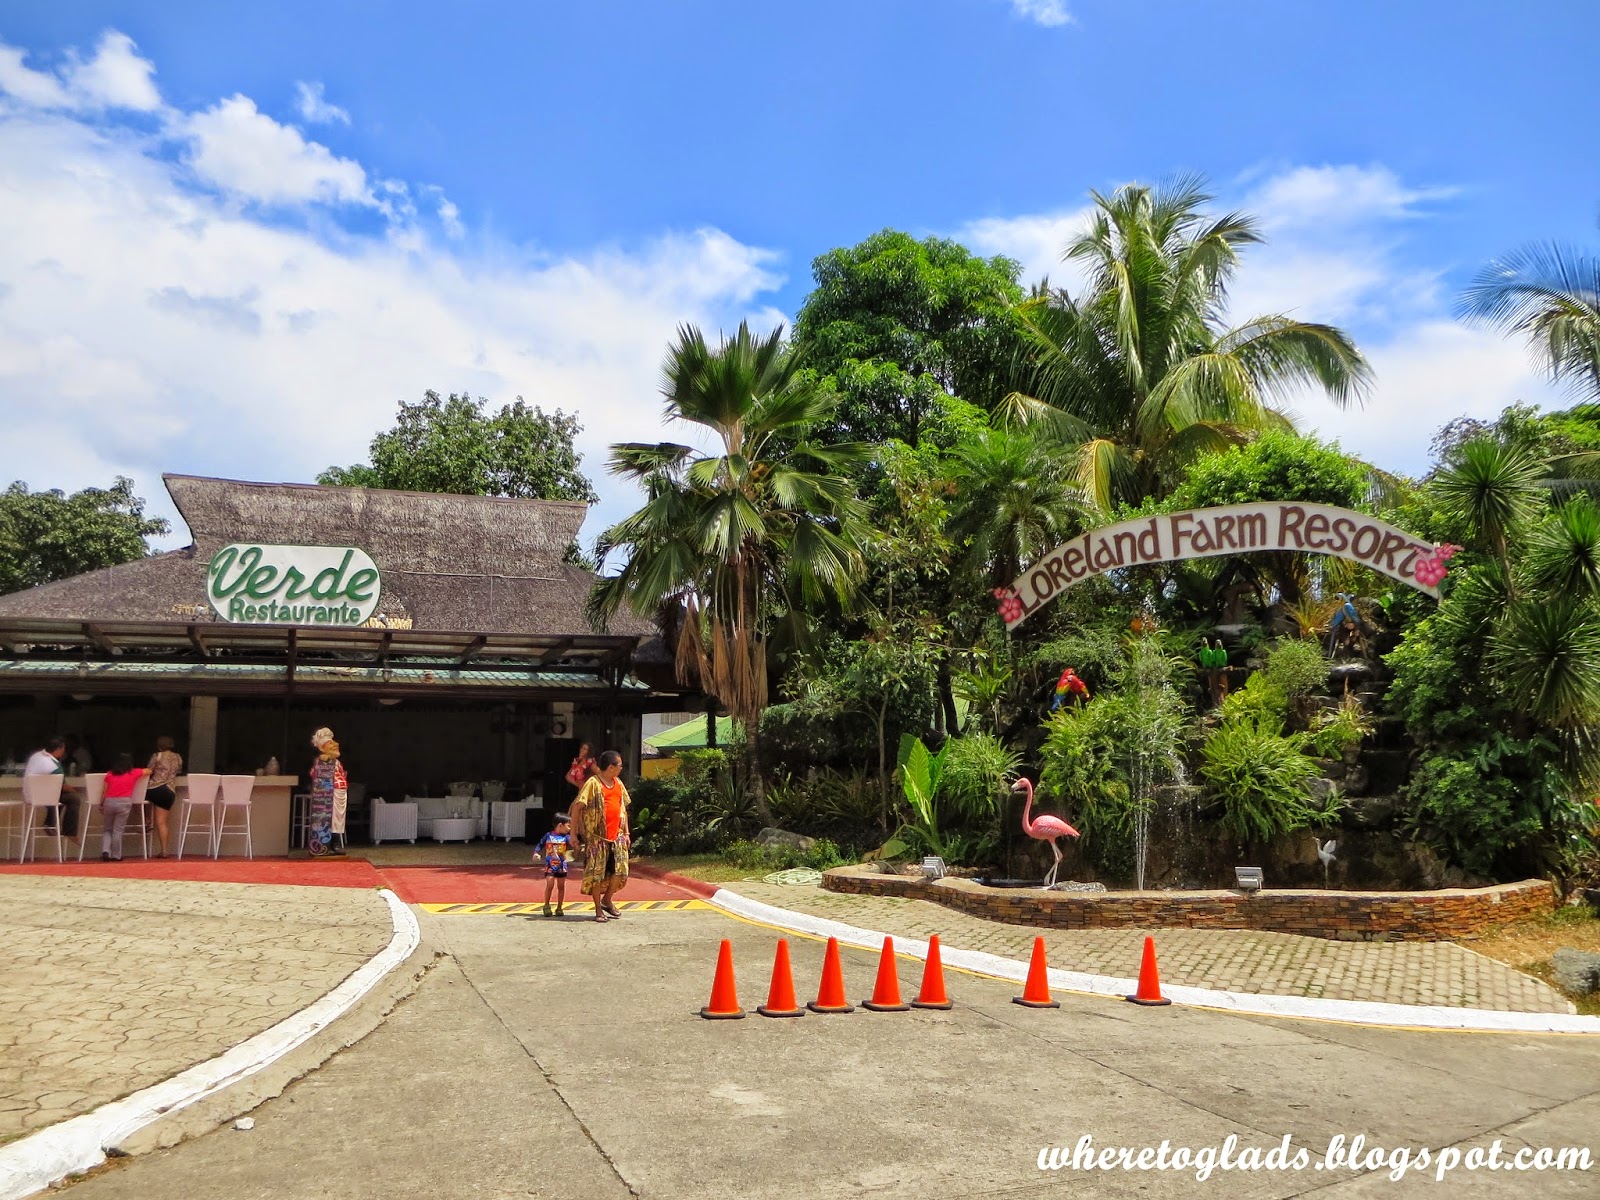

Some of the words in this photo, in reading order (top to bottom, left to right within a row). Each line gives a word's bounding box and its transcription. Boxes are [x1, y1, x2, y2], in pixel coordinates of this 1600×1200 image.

[1171, 512, 1267, 558] Farm
[211, 546, 378, 602] Verde
[228, 598, 361, 624] Restaurante
